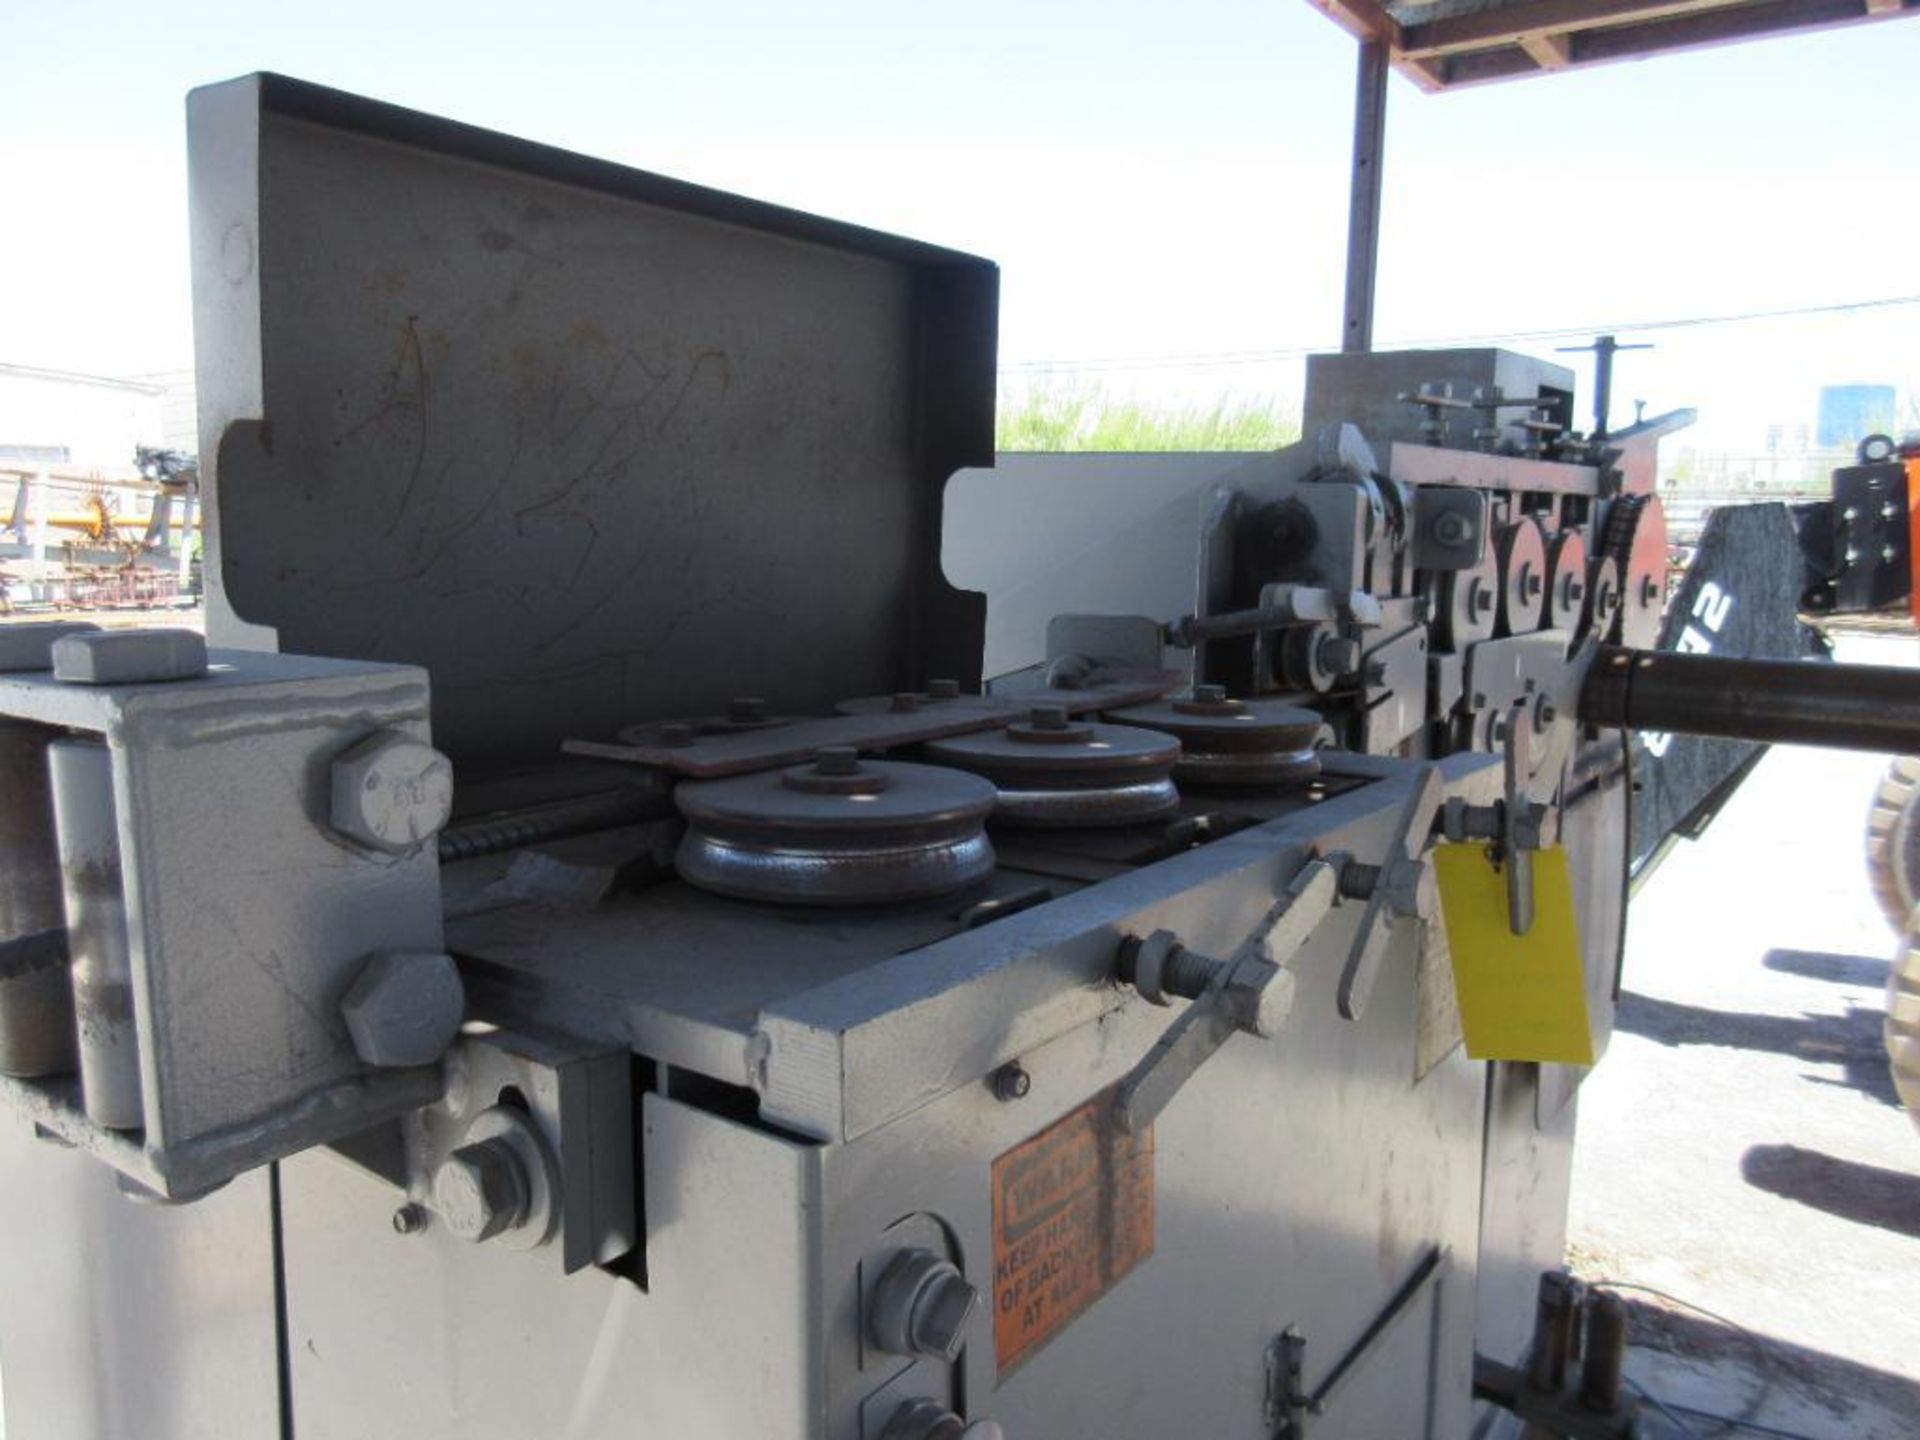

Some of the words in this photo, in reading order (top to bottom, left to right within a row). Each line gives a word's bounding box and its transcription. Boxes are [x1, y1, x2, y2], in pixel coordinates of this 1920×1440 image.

[997, 1232, 1041, 1284] KEEP
[1028, 1239, 1072, 1294] BACK
[1023, 1293, 1043, 1332] AT
